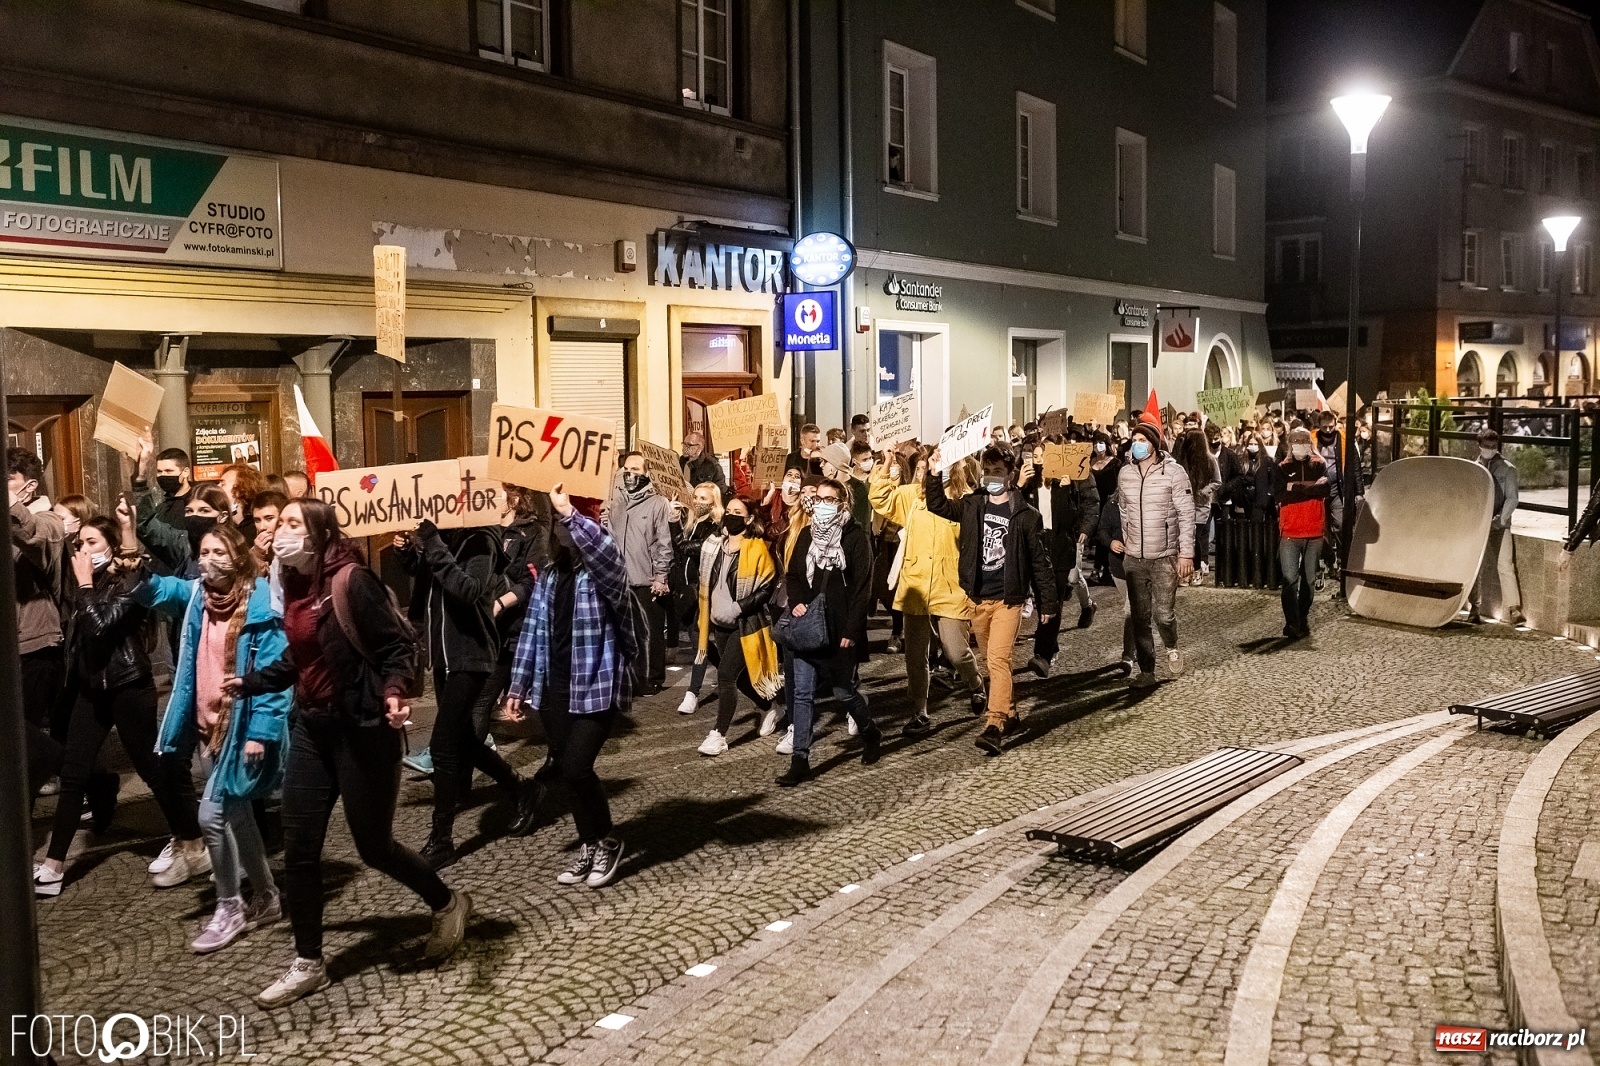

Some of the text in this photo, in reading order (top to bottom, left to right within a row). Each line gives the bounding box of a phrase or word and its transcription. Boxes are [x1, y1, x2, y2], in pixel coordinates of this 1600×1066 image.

[207, 202, 266, 222] STUDIO
[3, 210, 170, 241] FOTOGRAFICZNE
[189, 220, 274, 240] CYFR@FOTO
[183, 242, 275, 257] www.fotokaminski.pl
[655, 230, 784, 293] KANTOR
[803, 252, 839, 264] KANTOR
[900, 279, 943, 298] Santander
[900, 299, 943, 312] Consumer Bank
[1124, 303, 1149, 317] Santander
[1124, 317, 1141, 327] Consumer
[787, 333, 831, 345] Monetia
[195, 403, 252, 413] CYFR@FOTO
[711, 397, 775, 419] NO KACZUSZKO
[879, 401, 895, 415] KAJA
[1203, 399, 1250, 414] KAJA GODEK
[712, 416, 738, 430] KONIEC
[966, 405, 992, 428] PRECZ
[195, 427, 227, 437] Zdjęcia do
[687, 421, 704, 431] ANTOR
[195, 432, 256, 445] DOKUMENTÓW
[956, 430, 968, 440] OD
[560, 427, 613, 475] OFF
[760, 452, 787, 464] KOBIET
[1046, 452, 1074, 468] PIS
[388, 478, 410, 522] AN
